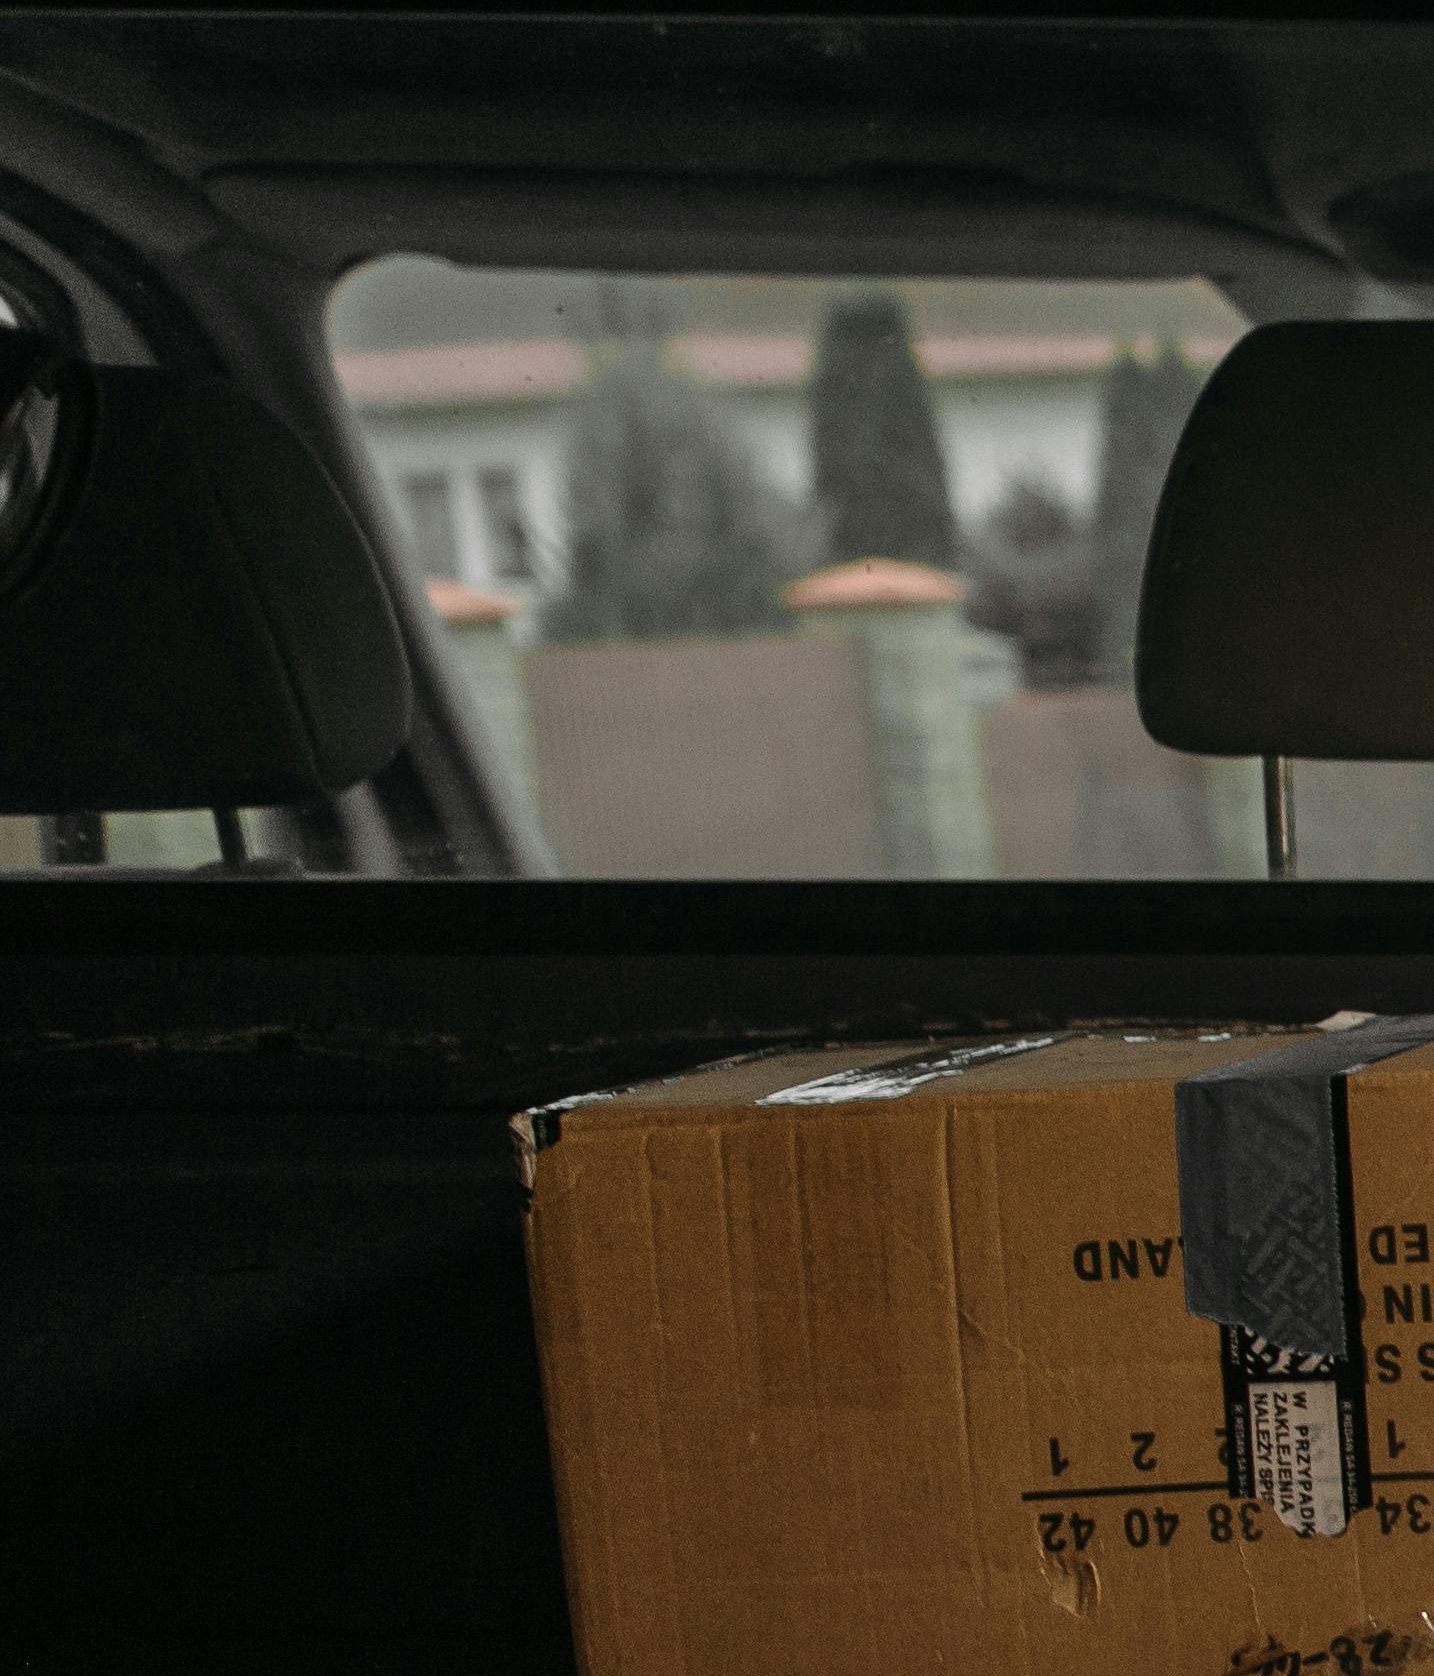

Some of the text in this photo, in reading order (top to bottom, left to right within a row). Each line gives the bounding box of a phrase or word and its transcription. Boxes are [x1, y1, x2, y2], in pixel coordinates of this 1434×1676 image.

[1073, 1235, 1184, 1282] AND
[1383, 1283, 1432, 1324] IN
[1293, 1391, 1307, 1409] W
[1049, 1420, 1405, 1477] 1 2 1
[1253, 1393, 1274, 1465] NALEŻY
[1273, 1391, 1294, 1513] ZAKLEJENIA
[1039, 1494, 1431, 1554] 34 38 40 42
